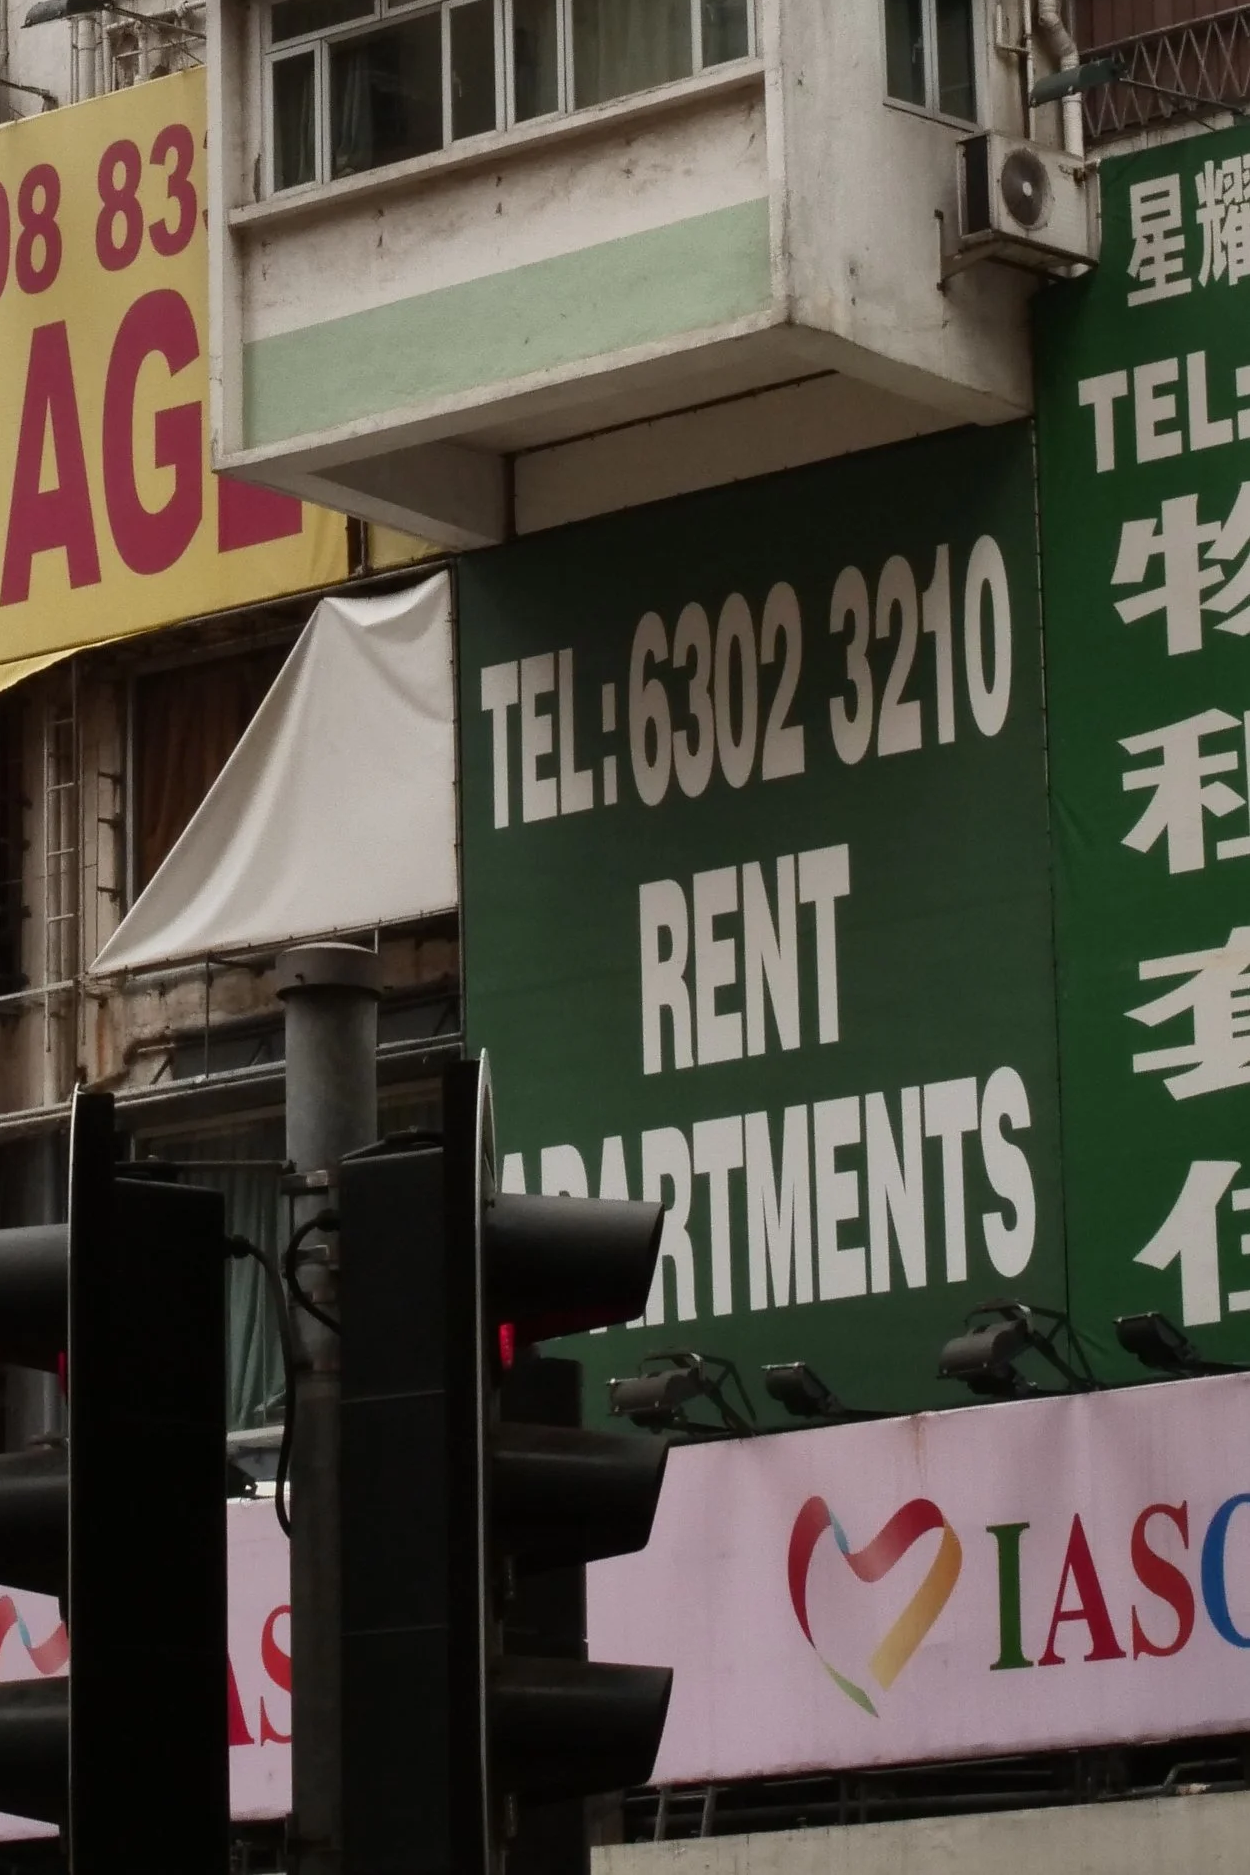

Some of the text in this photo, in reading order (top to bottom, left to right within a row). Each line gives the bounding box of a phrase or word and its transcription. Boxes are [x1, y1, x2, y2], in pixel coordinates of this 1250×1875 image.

[96, 123, 209, 272] 83
[1078, 351, 1250, 474] TEL:
[829, 534, 1012, 766] 3210
[639, 844, 851, 1076] RENT
